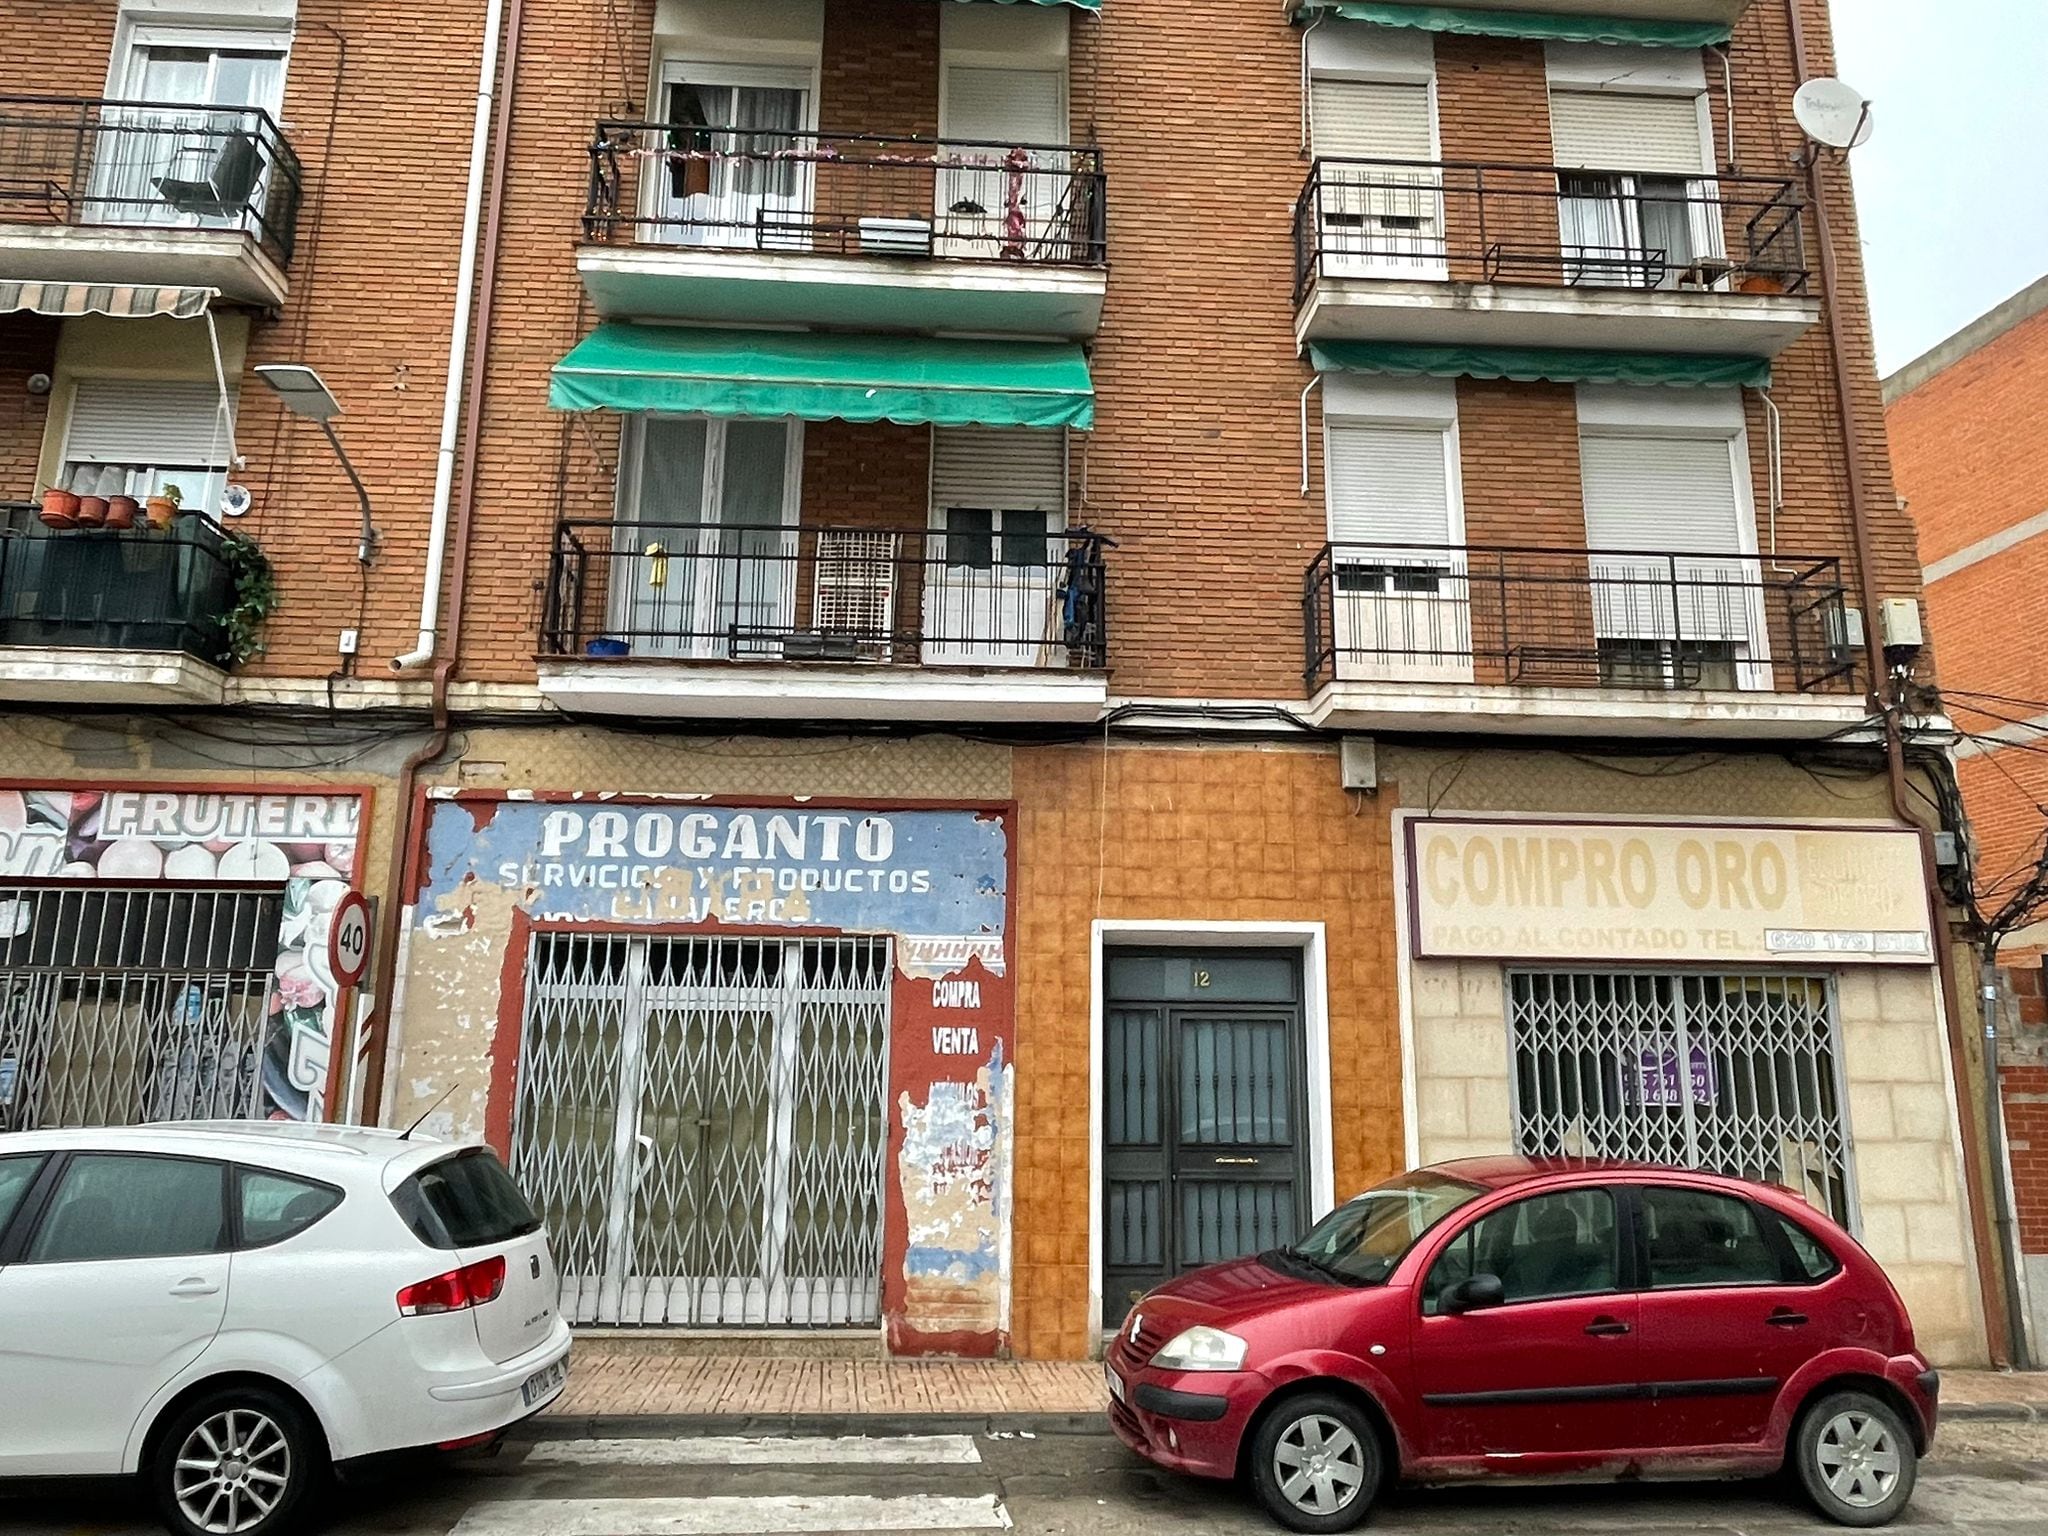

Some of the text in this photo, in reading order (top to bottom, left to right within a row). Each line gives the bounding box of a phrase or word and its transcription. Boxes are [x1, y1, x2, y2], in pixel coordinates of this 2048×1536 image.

[106, 793, 361, 836] FRUTERI
[540, 810, 894, 862] PROGANTO
[697, 866, 714, 889] Y
[1425, 835, 1657, 910] COMPRO
[1675, 838, 1789, 912] ORO
[340, 923, 363, 955] 40
[1432, 925, 1505, 947] PAGO
[1517, 926, 1546, 947] AL
[1557, 928, 1688, 950] CONTADO
[1193, 971, 1210, 987] 12
[932, 980, 981, 1009] COMPRA
[932, 1027, 979, 1055] VENTA
